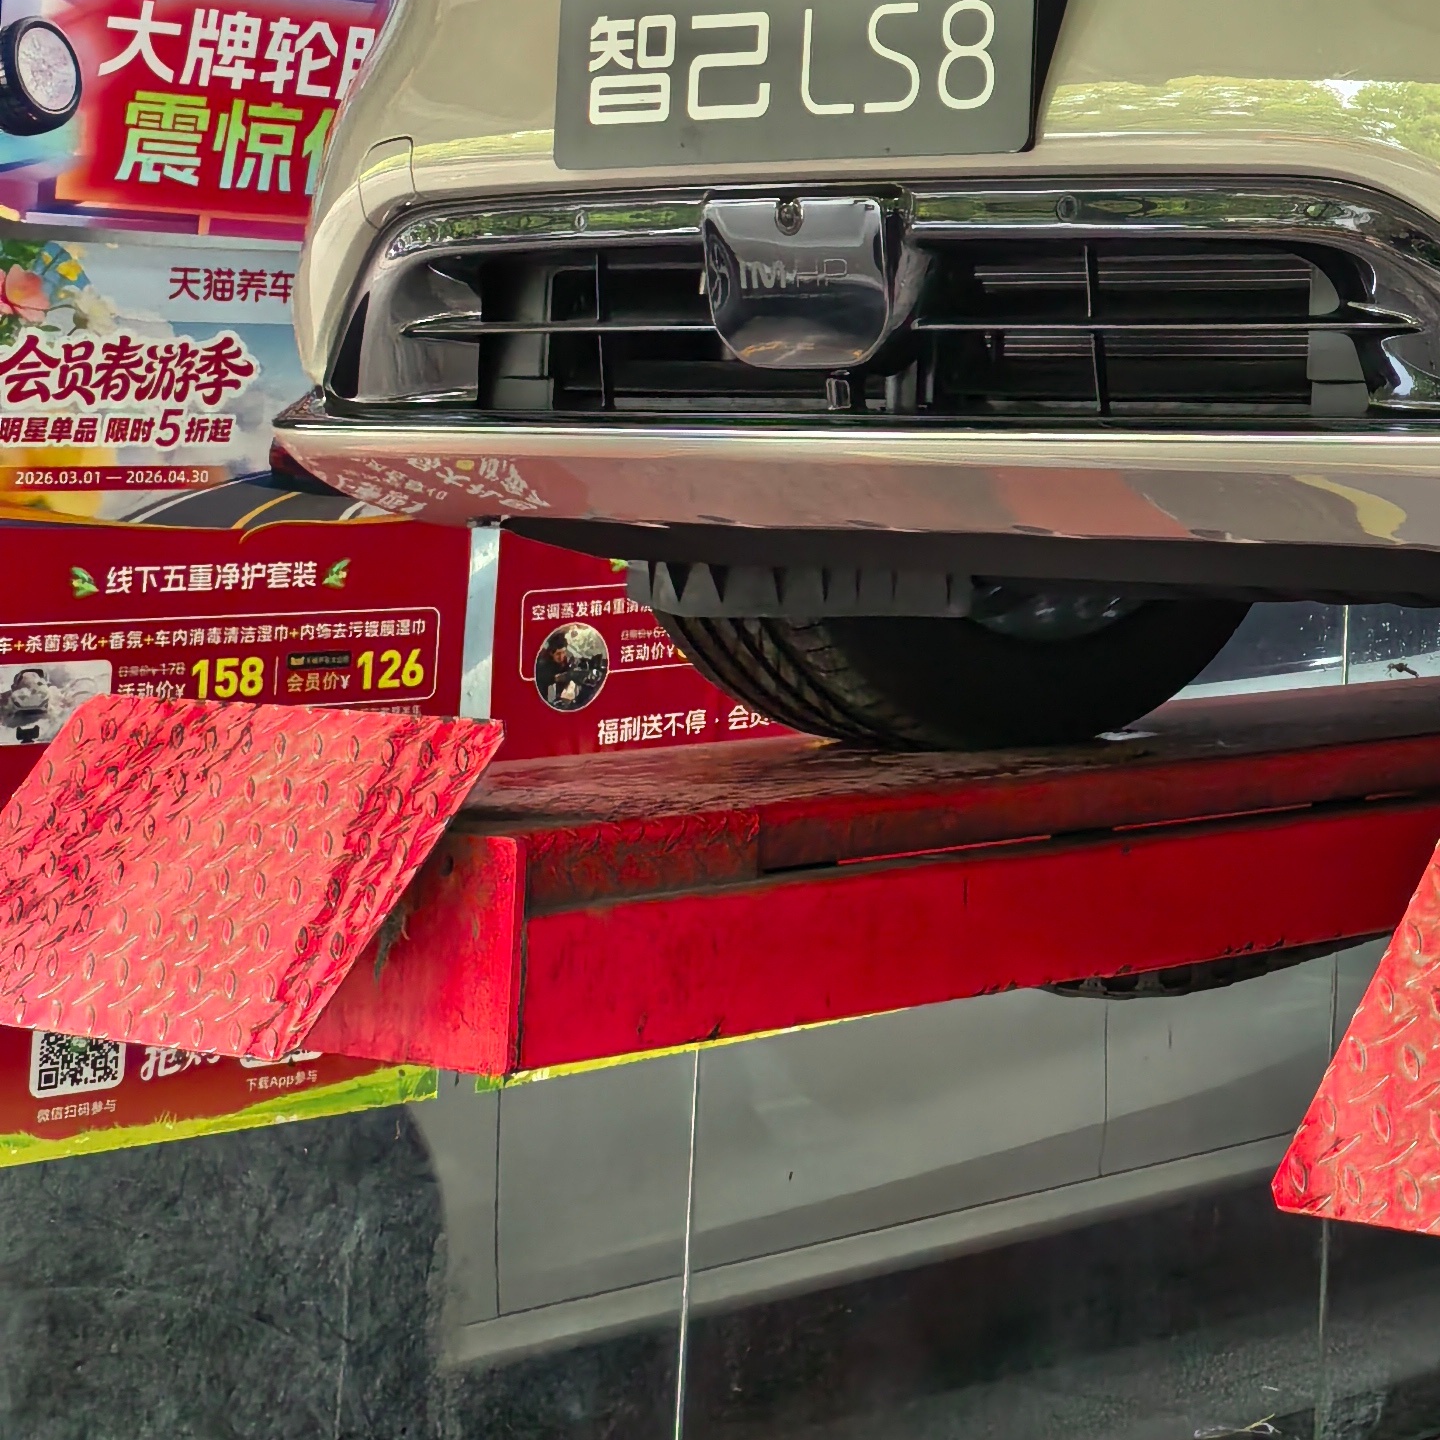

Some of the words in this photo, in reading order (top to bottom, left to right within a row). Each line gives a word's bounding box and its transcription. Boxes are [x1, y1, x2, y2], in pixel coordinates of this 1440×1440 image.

[588, 13, 771, 126] 智己
[800, 0, 996, 115] LS8
[168, 266, 296, 304] 天猫养车
[0, 335, 255, 406] 会员春游季
[0, 417, 98, 444] 明星单品
[104, 408, 234, 447] 限时5折起
[15, 470, 101, 485] 2026.03.01
[126, 470, 209, 484] 2026.04.30
[105, 561, 319, 595] 线下五重净护套装
[192, 656, 264, 699] 158
[357, 648, 425, 692] 126
[246, 1069, 319, 1092] 下载App参与
[37, 1099, 117, 1123] 微信扫码参与
